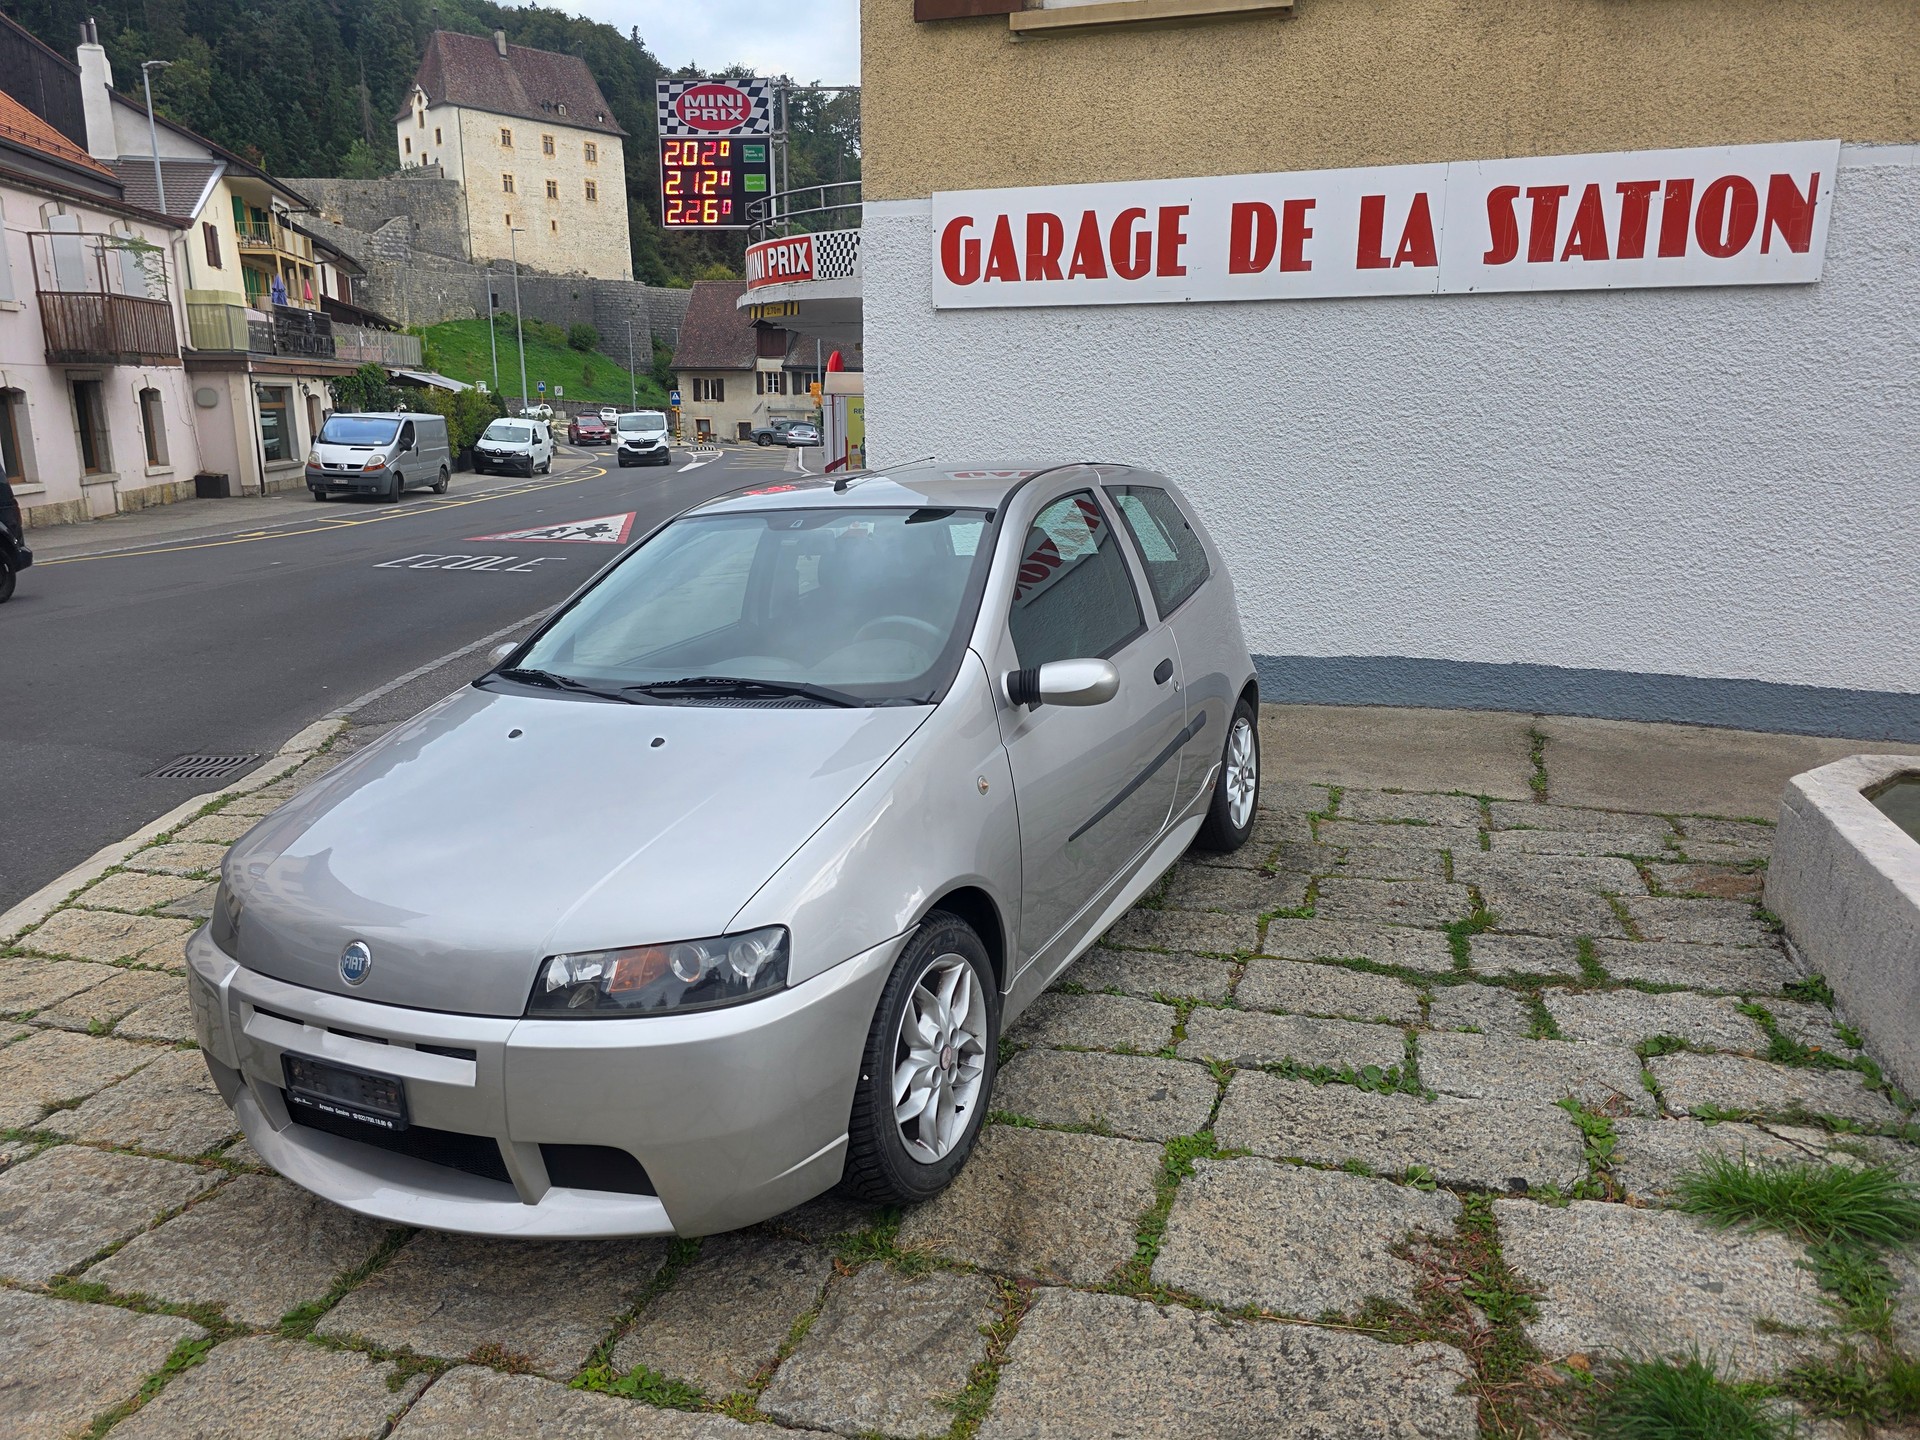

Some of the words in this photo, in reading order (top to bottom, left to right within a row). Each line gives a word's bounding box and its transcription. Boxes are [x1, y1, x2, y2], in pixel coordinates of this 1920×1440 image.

[684, 94, 743, 107] MINI
[684, 108, 744, 121] PRIX
[941, 205, 1190, 286] GARAGE
[1229, 198, 1317, 275] DE
[1356, 192, 1439, 270] LA
[1483, 172, 1821, 266] STATION
[767, 242, 810, 278] PRIX
[372, 554, 567, 572] ECOLE
[344, 955, 365, 971] FIAT
